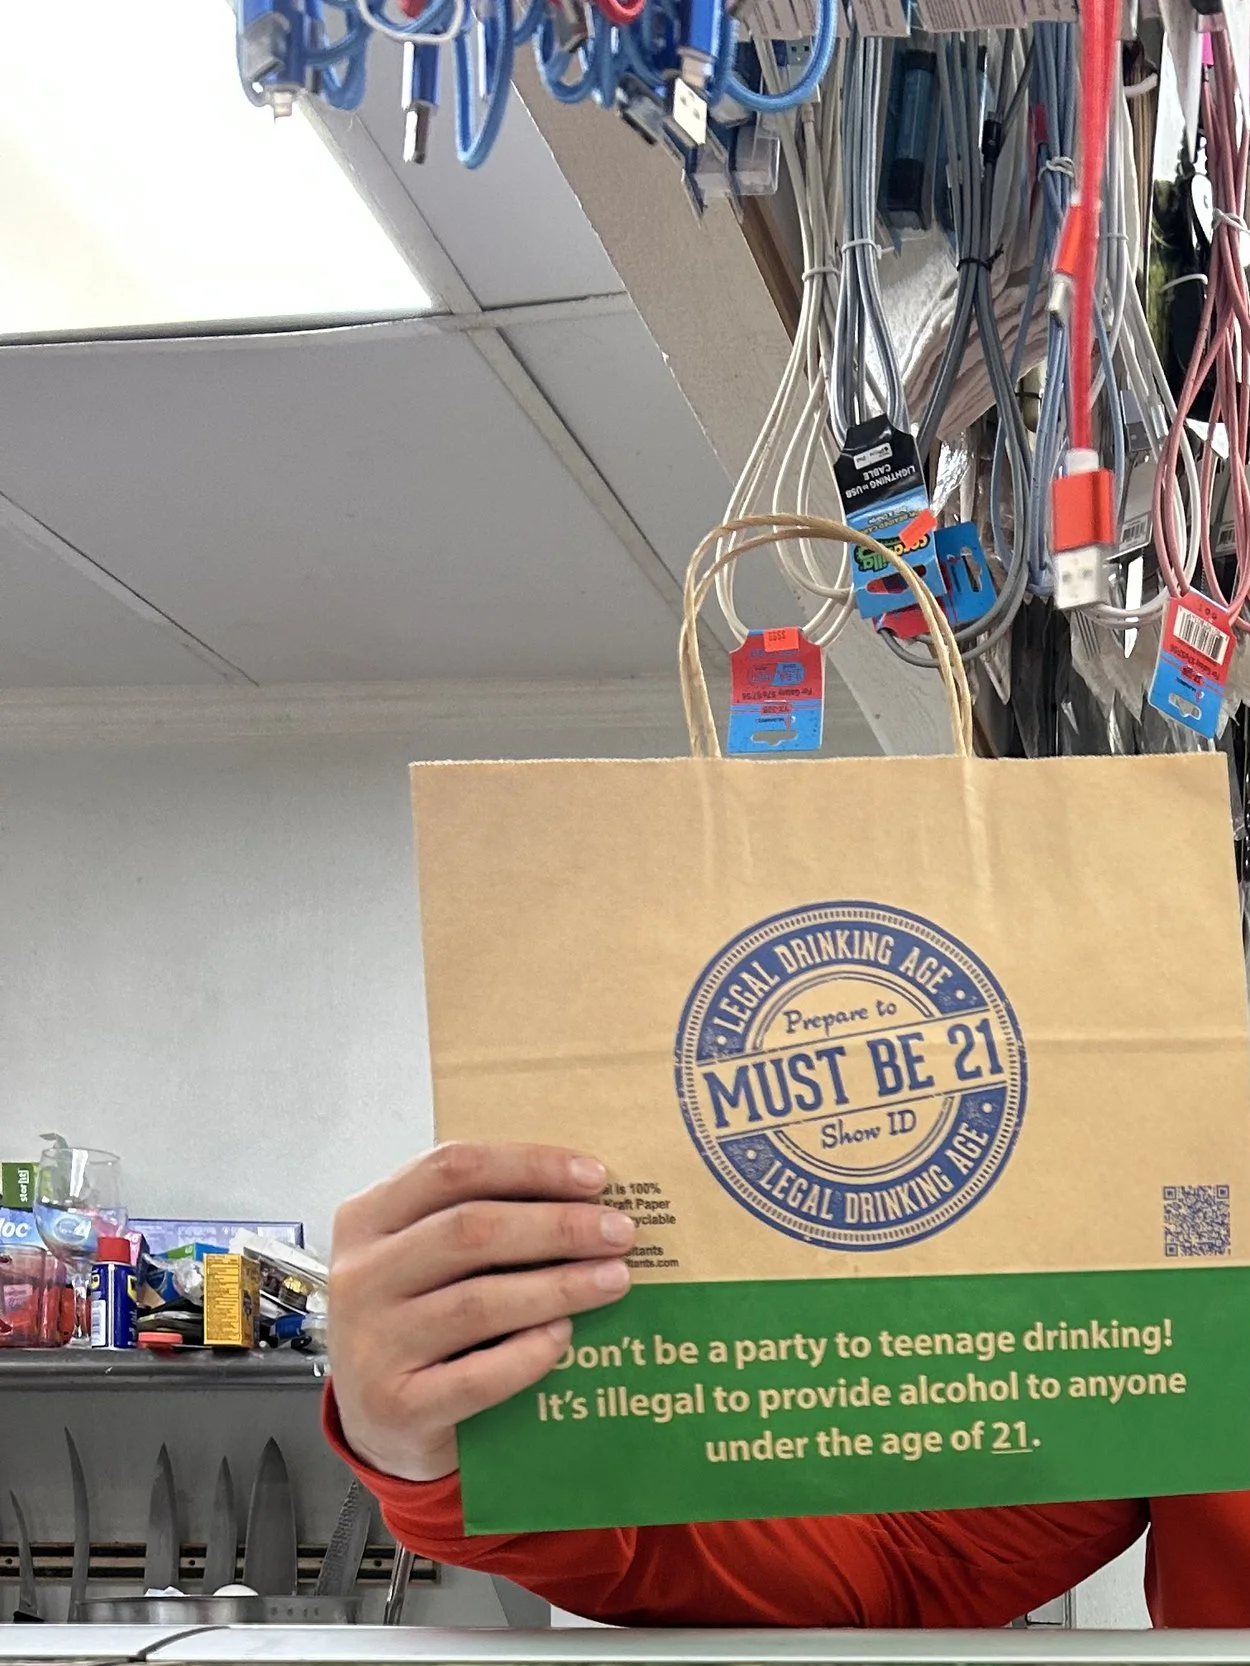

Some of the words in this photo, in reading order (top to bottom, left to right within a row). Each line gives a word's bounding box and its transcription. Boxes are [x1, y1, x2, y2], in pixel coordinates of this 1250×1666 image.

[846, 484, 864, 499] USB
[863, 464, 892, 481] CABLE
[870, 464, 916, 490] LIGHTNING
[714, 960, 781, 1034] LEGAL
[773, 928, 895, 973] DRINKING
[898, 945, 953, 995] AGE
[783, 1004, 869, 1037] Prepare
[876, 999, 897, 1018] to
[702, 1045, 850, 1129] MUST
[865, 1031, 934, 1098] BE
[946, 1017, 1005, 1081] 21
[820, 1118, 881, 1150] Show
[887, 1108, 918, 1137] ID
[629, 1182, 662, 1195] 100%
[758, 1158, 834, 1221] LEGAL
[844, 1163, 954, 1225] DRINKING
[943, 1122, 989, 1176] AGE
[631, 1214, 677, 1228] yclable
[636, 1198, 671, 1212] Paper
[653, 1334, 700, 1365] be
[708, 1341, 728, 1364] a
[734, 1332, 828, 1370] party
[834, 1332, 872, 1359] to
[879, 1330, 1016, 1361] teenage
[1022, 1318, 1173, 1356] drinking!
[537, 1390, 589, 1422] It's
[596, 1382, 705, 1424] illegal
[712, 1386, 751, 1413] to
[758, 1376, 892, 1420] provide
[899, 1370, 1020, 1405] alcohol
[1026, 1373, 1061, 1400] to
[1068, 1371, 1188, 1405] anyone
[705, 1430, 809, 1463] under
[815, 1426, 874, 1457] the
[880, 1429, 943, 1462] age
[950, 1420, 985, 1452] of
[991, 1420, 1042, 1454] 21.
